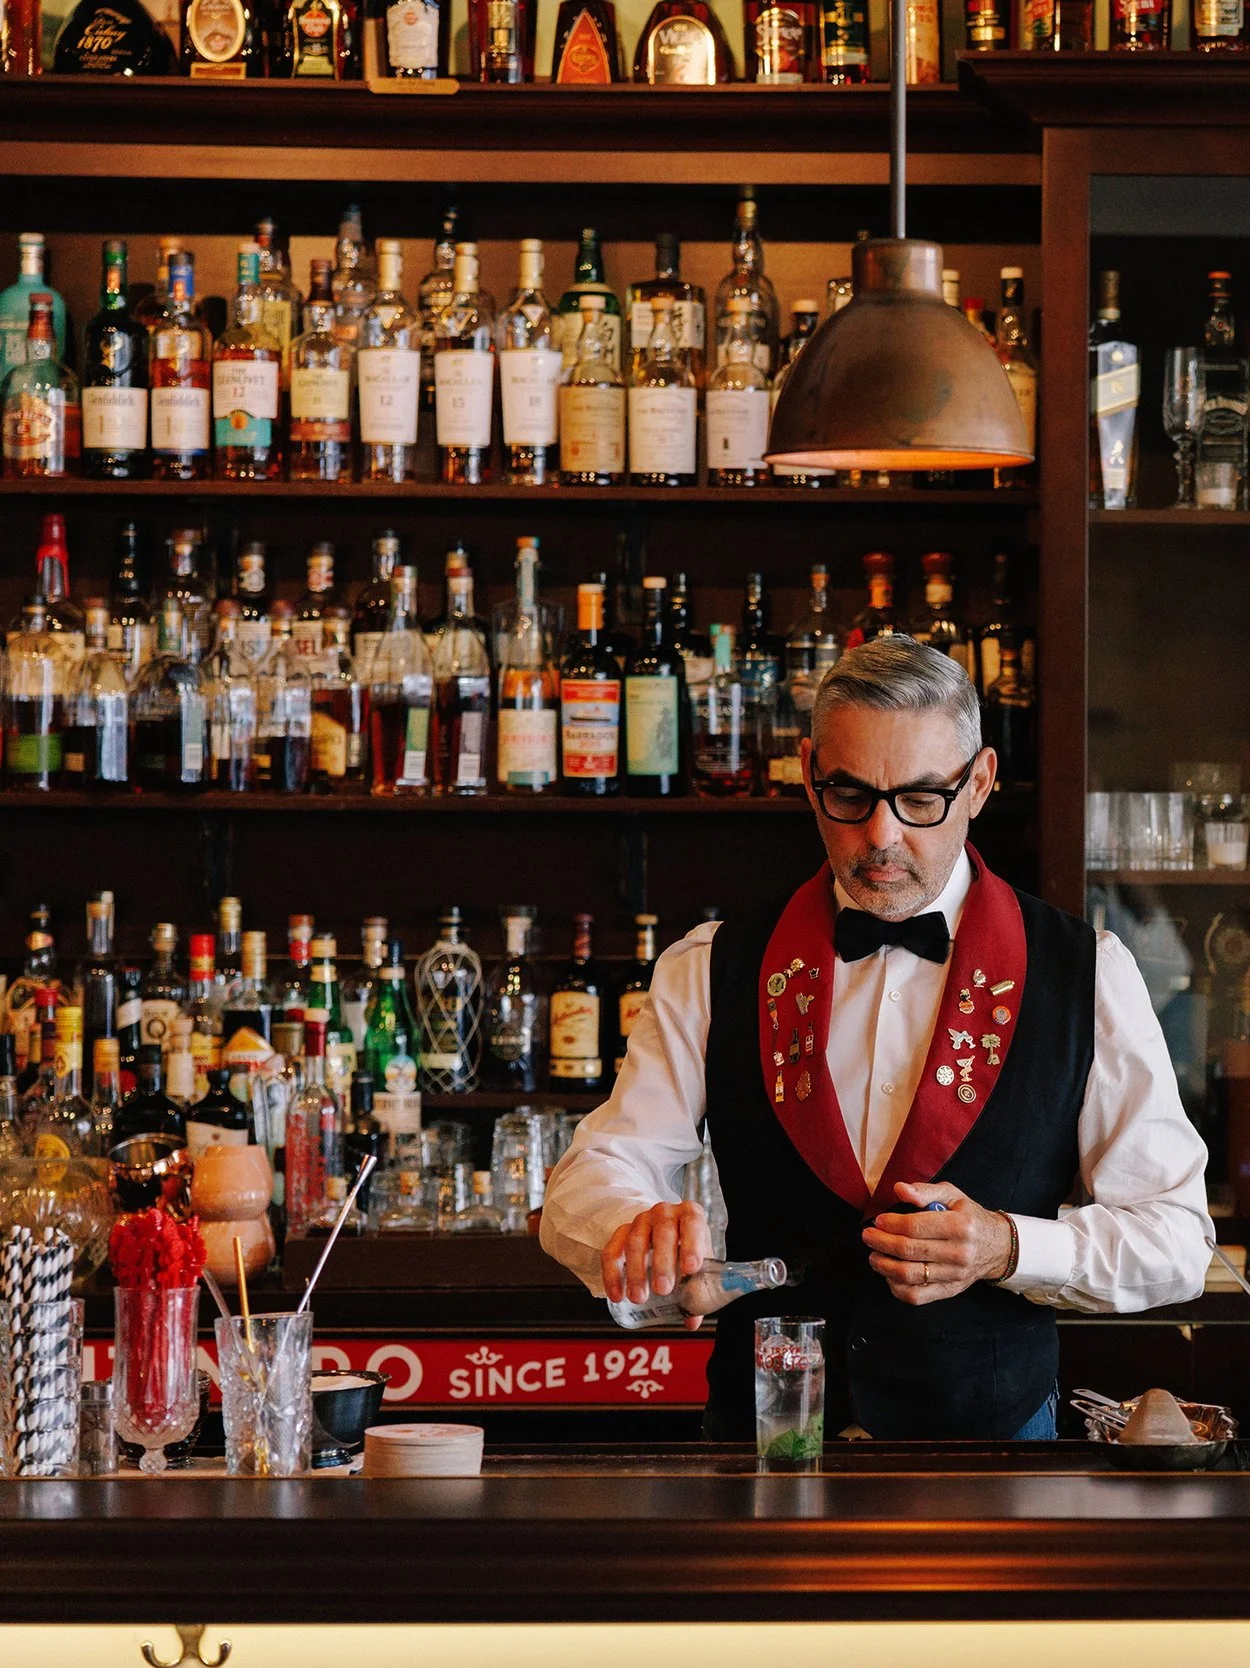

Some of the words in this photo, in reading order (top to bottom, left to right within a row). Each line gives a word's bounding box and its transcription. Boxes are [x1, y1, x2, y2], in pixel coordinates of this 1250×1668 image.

[77, 35, 113, 52] 1870
[449, 1357, 566, 1399] SINCE
[583, 1346, 673, 1383] 1924
